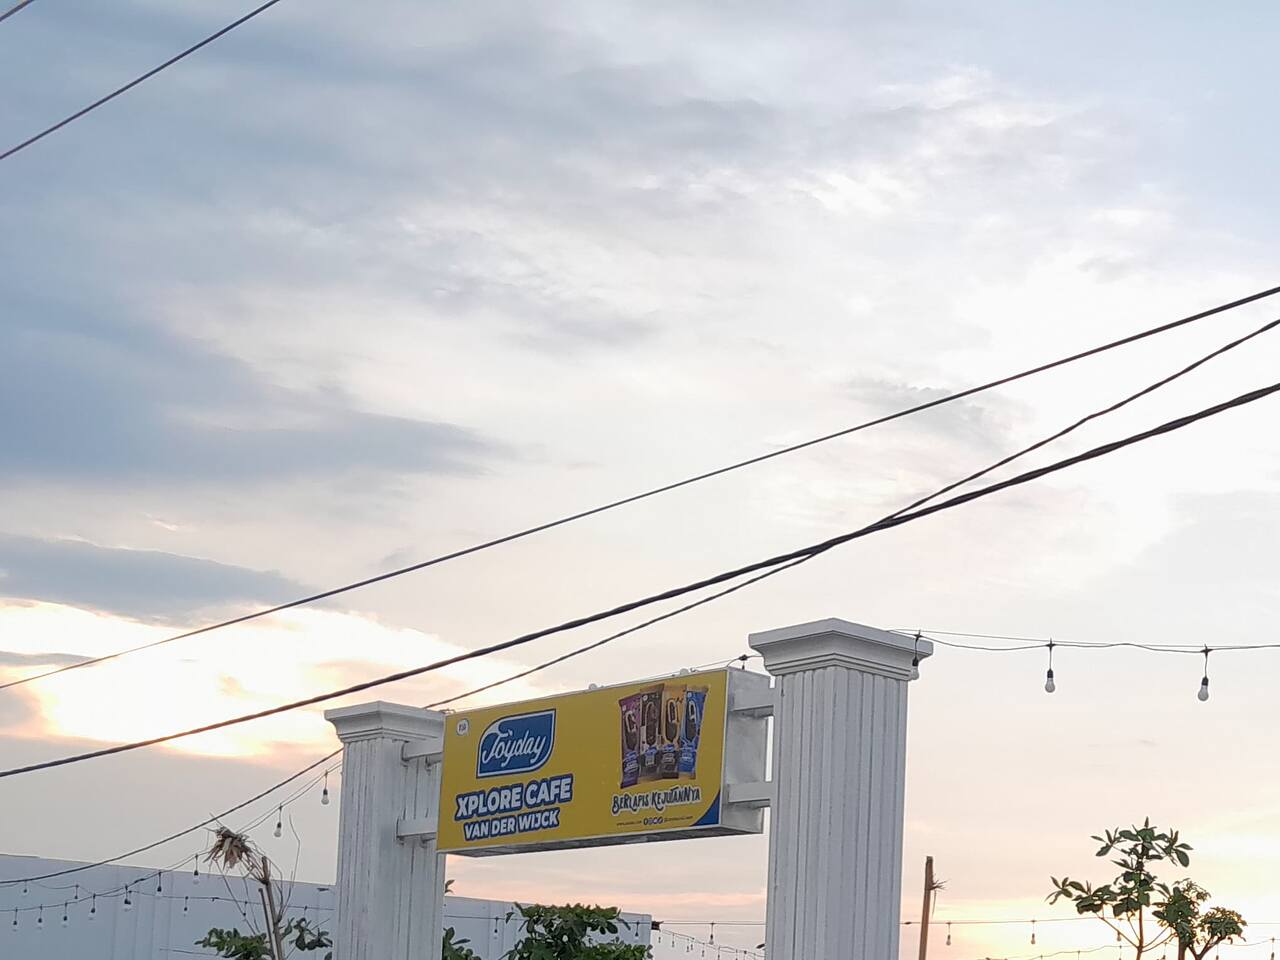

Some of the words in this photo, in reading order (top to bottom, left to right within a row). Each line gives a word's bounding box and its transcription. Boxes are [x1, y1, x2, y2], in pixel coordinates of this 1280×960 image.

[482, 728, 547, 768] Joyday
[456, 786, 522, 818] XPLORE
[525, 778, 571, 806] CAFE
[465, 821, 489, 840] VAN
[491, 817, 515, 836] DER
[518, 809, 560, 832] WIJCK
